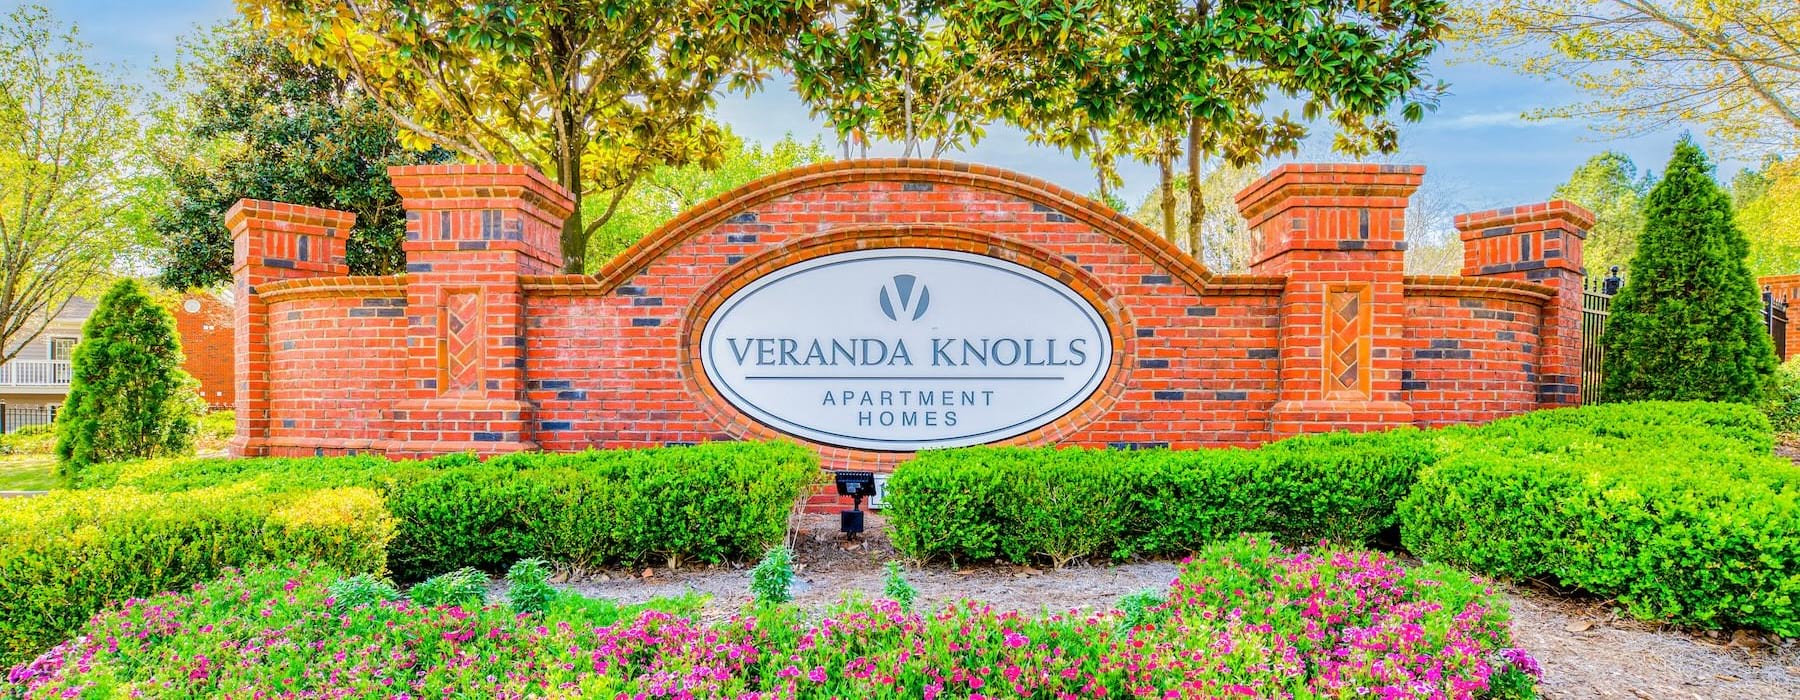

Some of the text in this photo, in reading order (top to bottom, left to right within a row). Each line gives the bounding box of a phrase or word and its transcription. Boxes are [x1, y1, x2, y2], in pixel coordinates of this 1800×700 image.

[726, 337, 1087, 367] VERANDA KNOLLS
[822, 390, 995, 406] APARTMENT
[858, 411, 958, 427] HOMES
